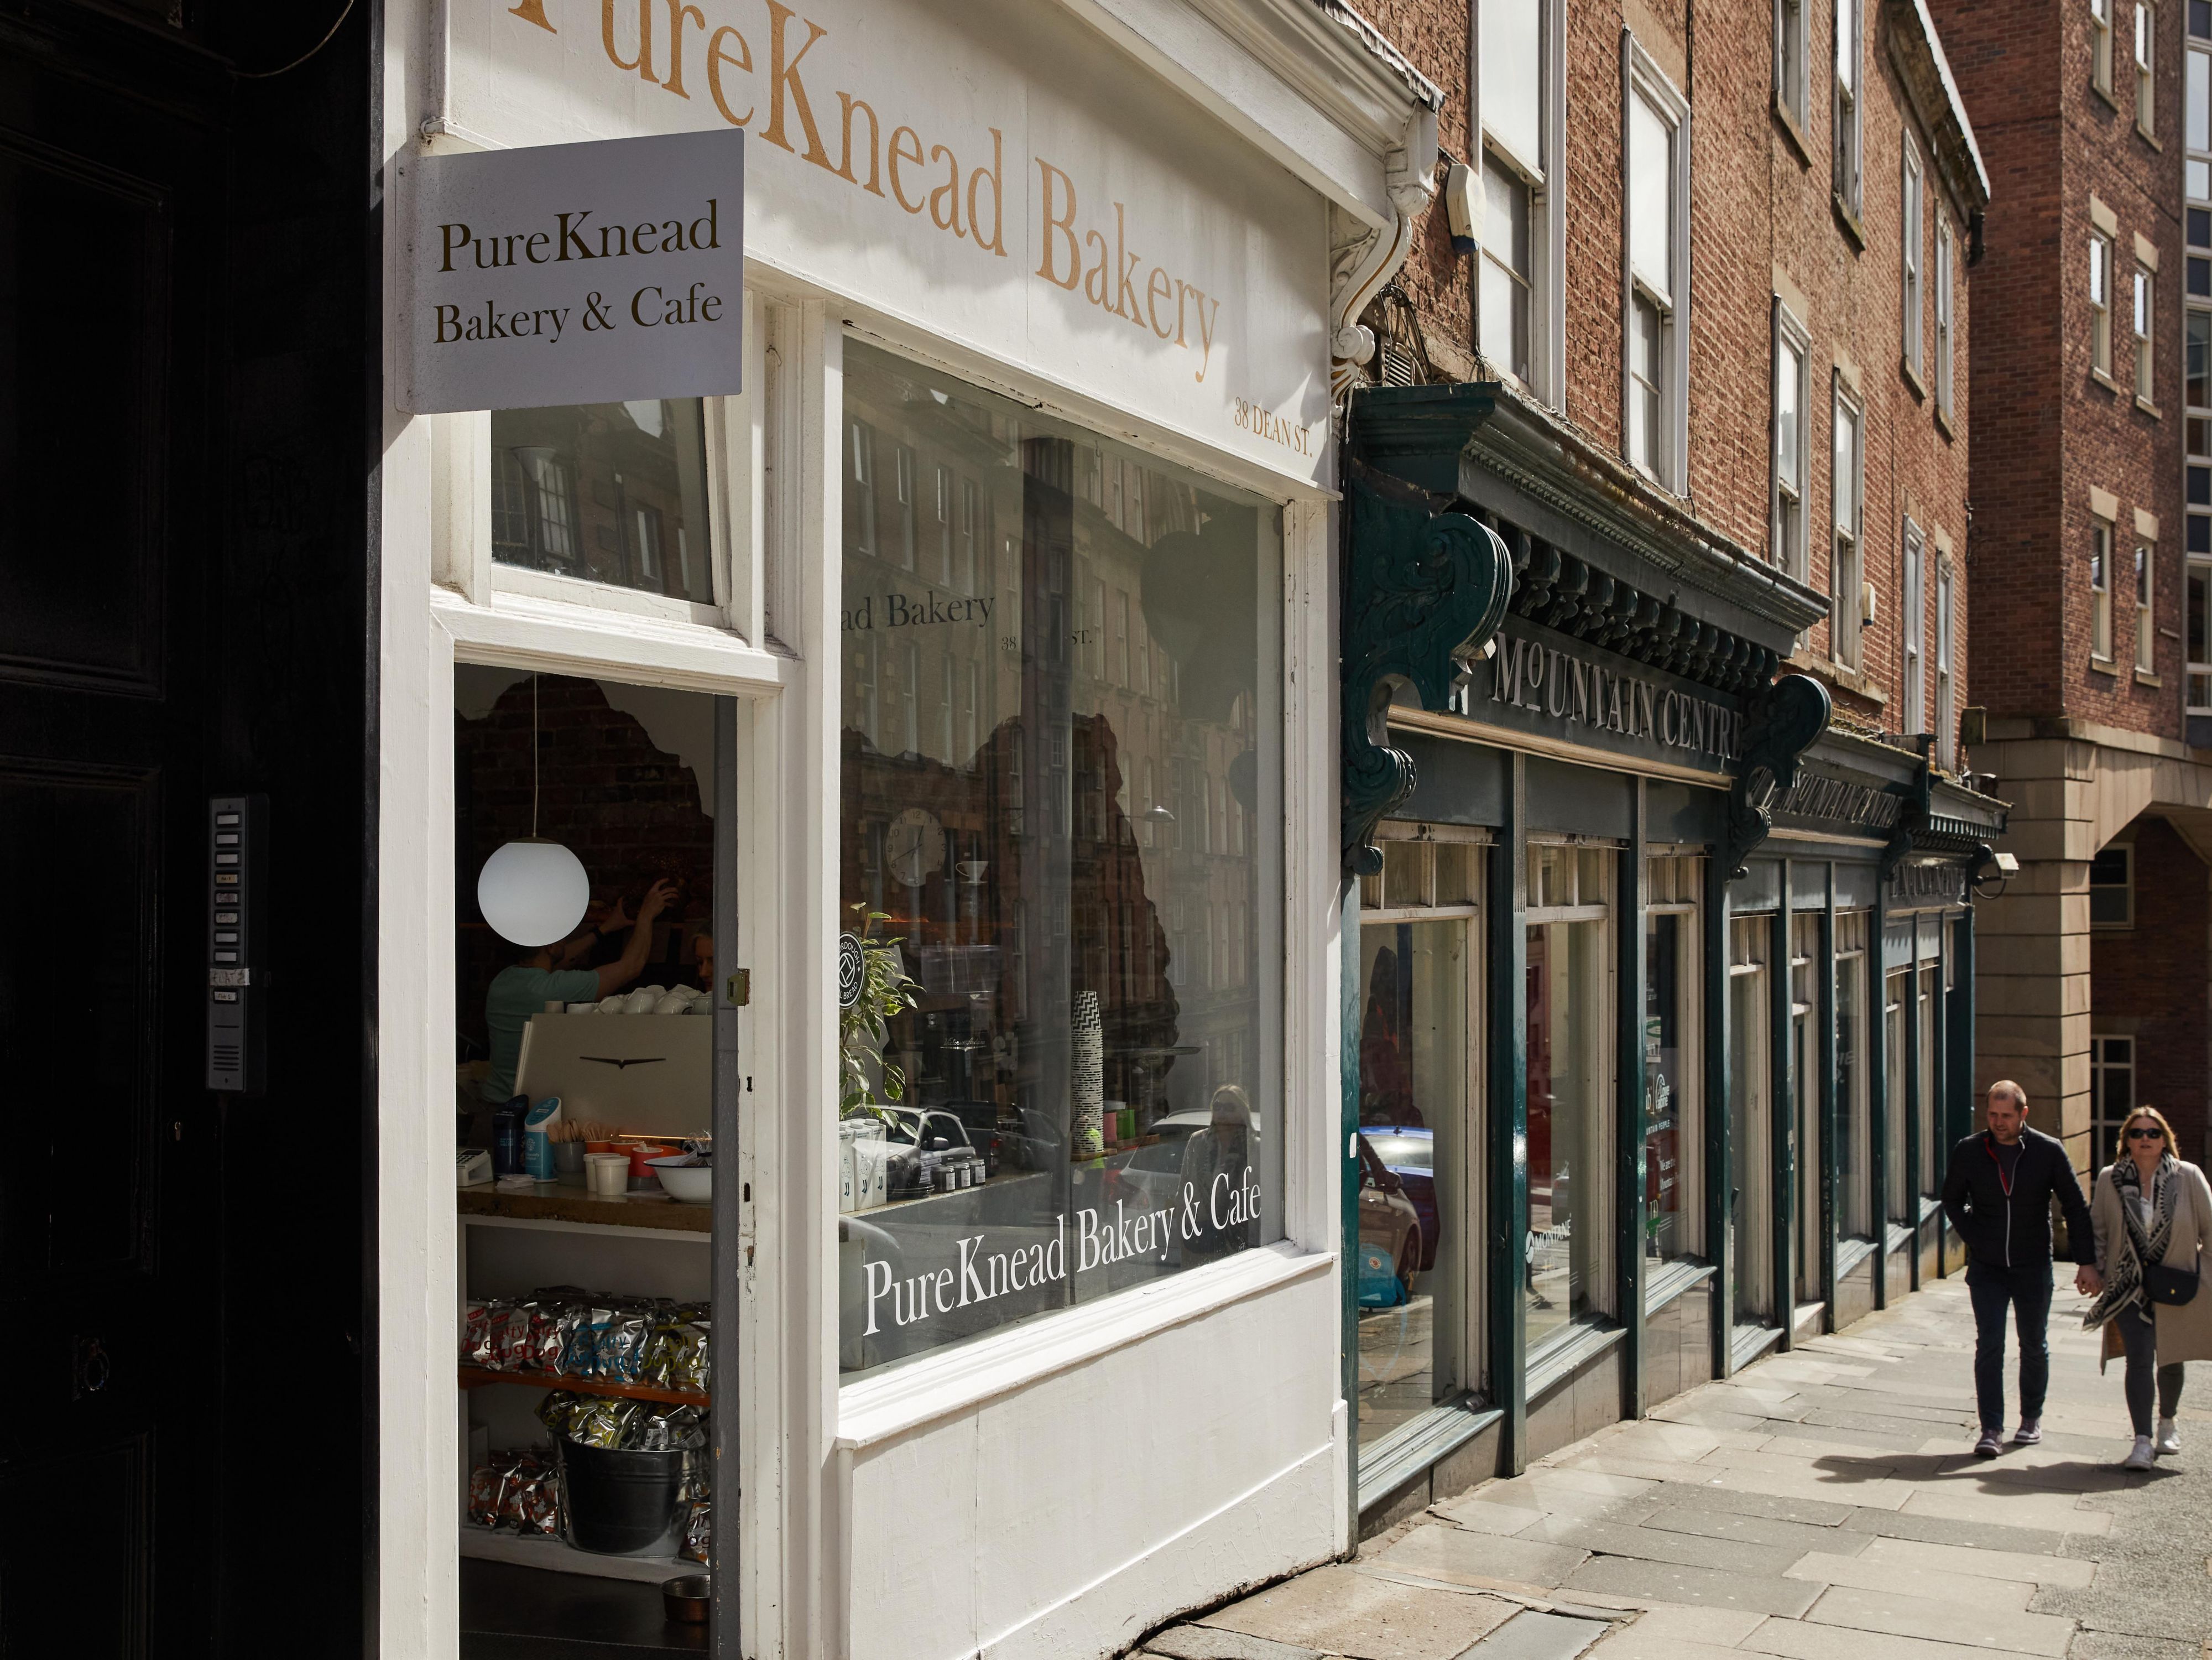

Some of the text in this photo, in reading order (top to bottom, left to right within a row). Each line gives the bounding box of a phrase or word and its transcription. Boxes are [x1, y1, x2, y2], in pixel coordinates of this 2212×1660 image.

[508, 0, 1220, 383] ureKnead Bakery
[437, 199, 721, 273] PureKnead
[434, 283, 722, 344] Bakery & Cafe
[1234, 397, 1313, 458] 38 DEAN ST.
[887, 591, 995, 627] Bakery
[1001, 637, 1016, 651] 38
[1662, 689, 1743, 762] CENTRE
[843, 981, 858, 1000] BREAD
[863, 1166, 1261, 1337] PureKnead Bakery & Cafe
[1535, 1219, 1571, 1253] MONTANE
